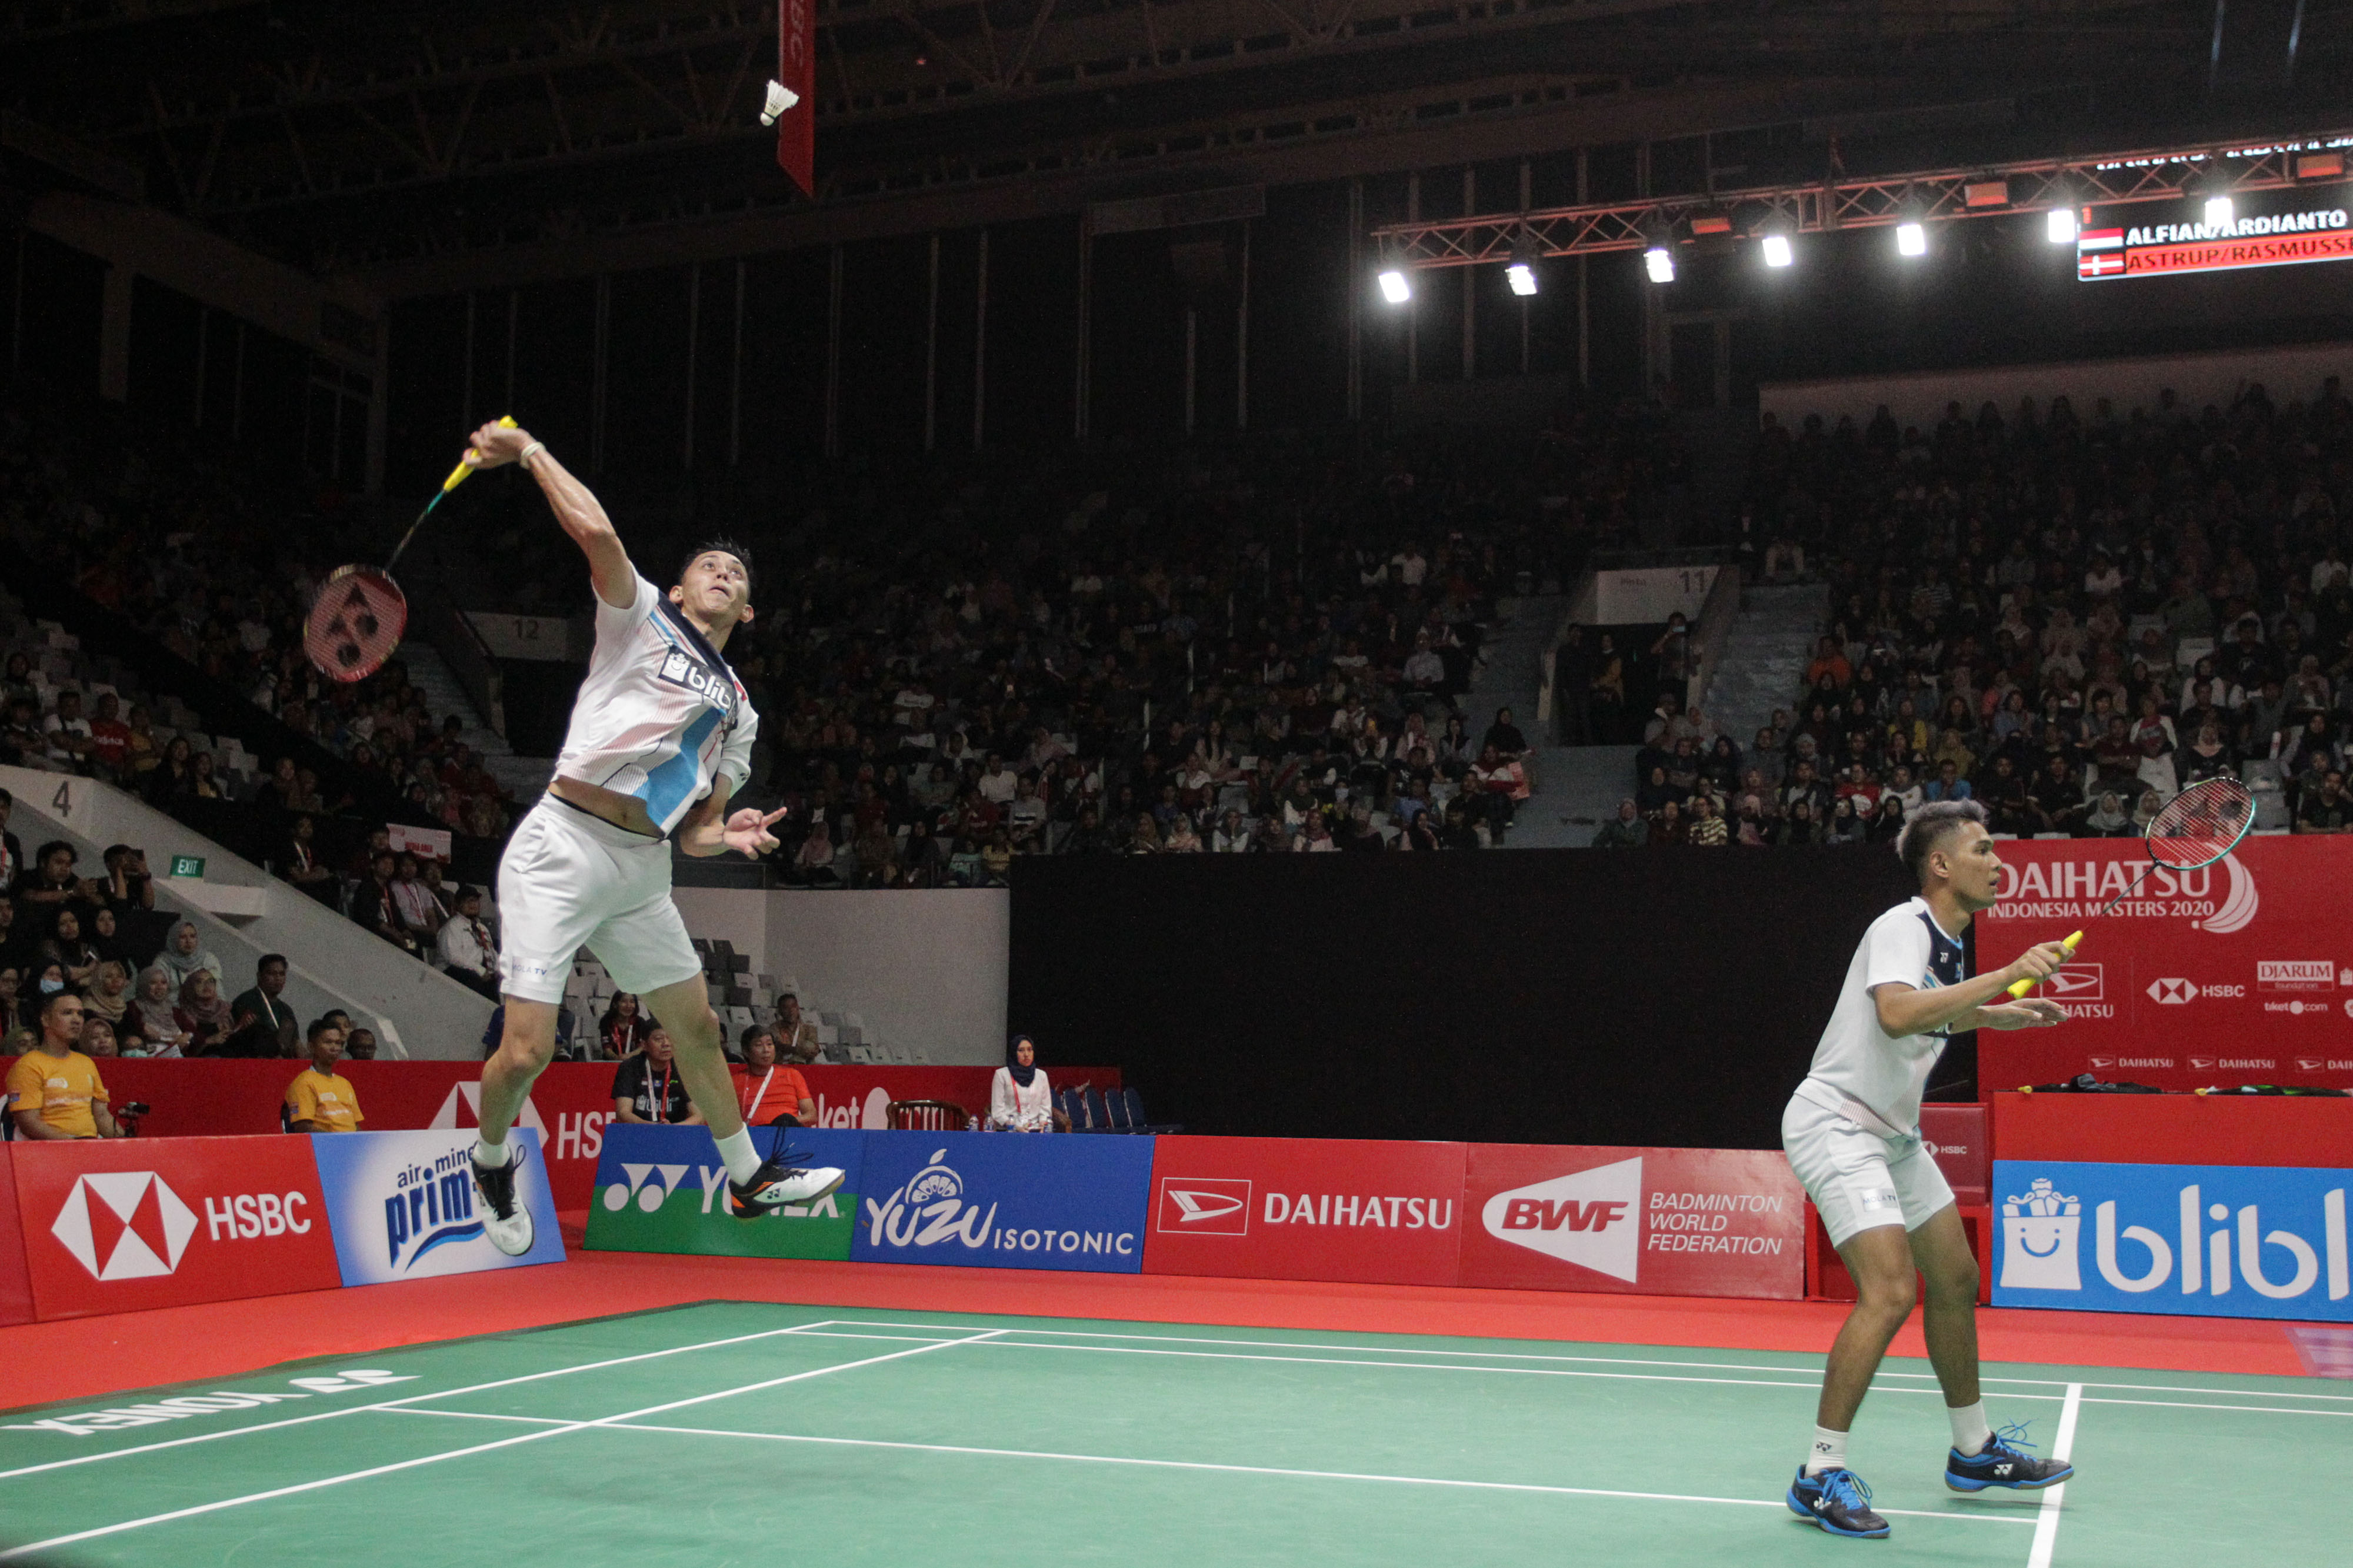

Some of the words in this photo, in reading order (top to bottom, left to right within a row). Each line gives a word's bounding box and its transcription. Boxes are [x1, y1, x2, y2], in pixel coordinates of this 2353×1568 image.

[1679, 569, 1705, 593] 11
[512, 619, 539, 640] 12
[52, 781, 71, 818] 4
[178, 859, 198, 875] EXIT
[1987, 902, 2082, 919] INDONESIA
[2085, 901, 2167, 918] MASTERS
[2171, 900, 2215, 916] 2020
[534, 968, 548, 976] TV
[2261, 965, 2330, 979] DJARUM
[2201, 985, 2245, 998] HSBC
[2062, 1004, 2115, 1019] HATSU
[2119, 1058, 2174, 1069] DAIHATSU
[2218, 1059, 2275, 1069] DAIHATSU
[557, 1111, 616, 1159] HS
[1941, 1145, 1967, 1154] HSBC
[397, 1164, 422, 1189] air
[1264, 1192, 1452, 1230] DAIHATSU
[1649, 1192, 1782, 1213] BADMINTON
[205, 1191, 312, 1241] HSBC
[385, 1166, 478, 1269] prim
[866, 1186, 998, 1248] YUZU
[994, 1228, 1134, 1255] ISOTONIC
[1501, 1198, 1629, 1232] BWF
[1649, 1213, 1728, 1232] WORLD
[1647, 1234, 1782, 1255] FEDERATION
[0, 1391, 314, 1436] YONEX
